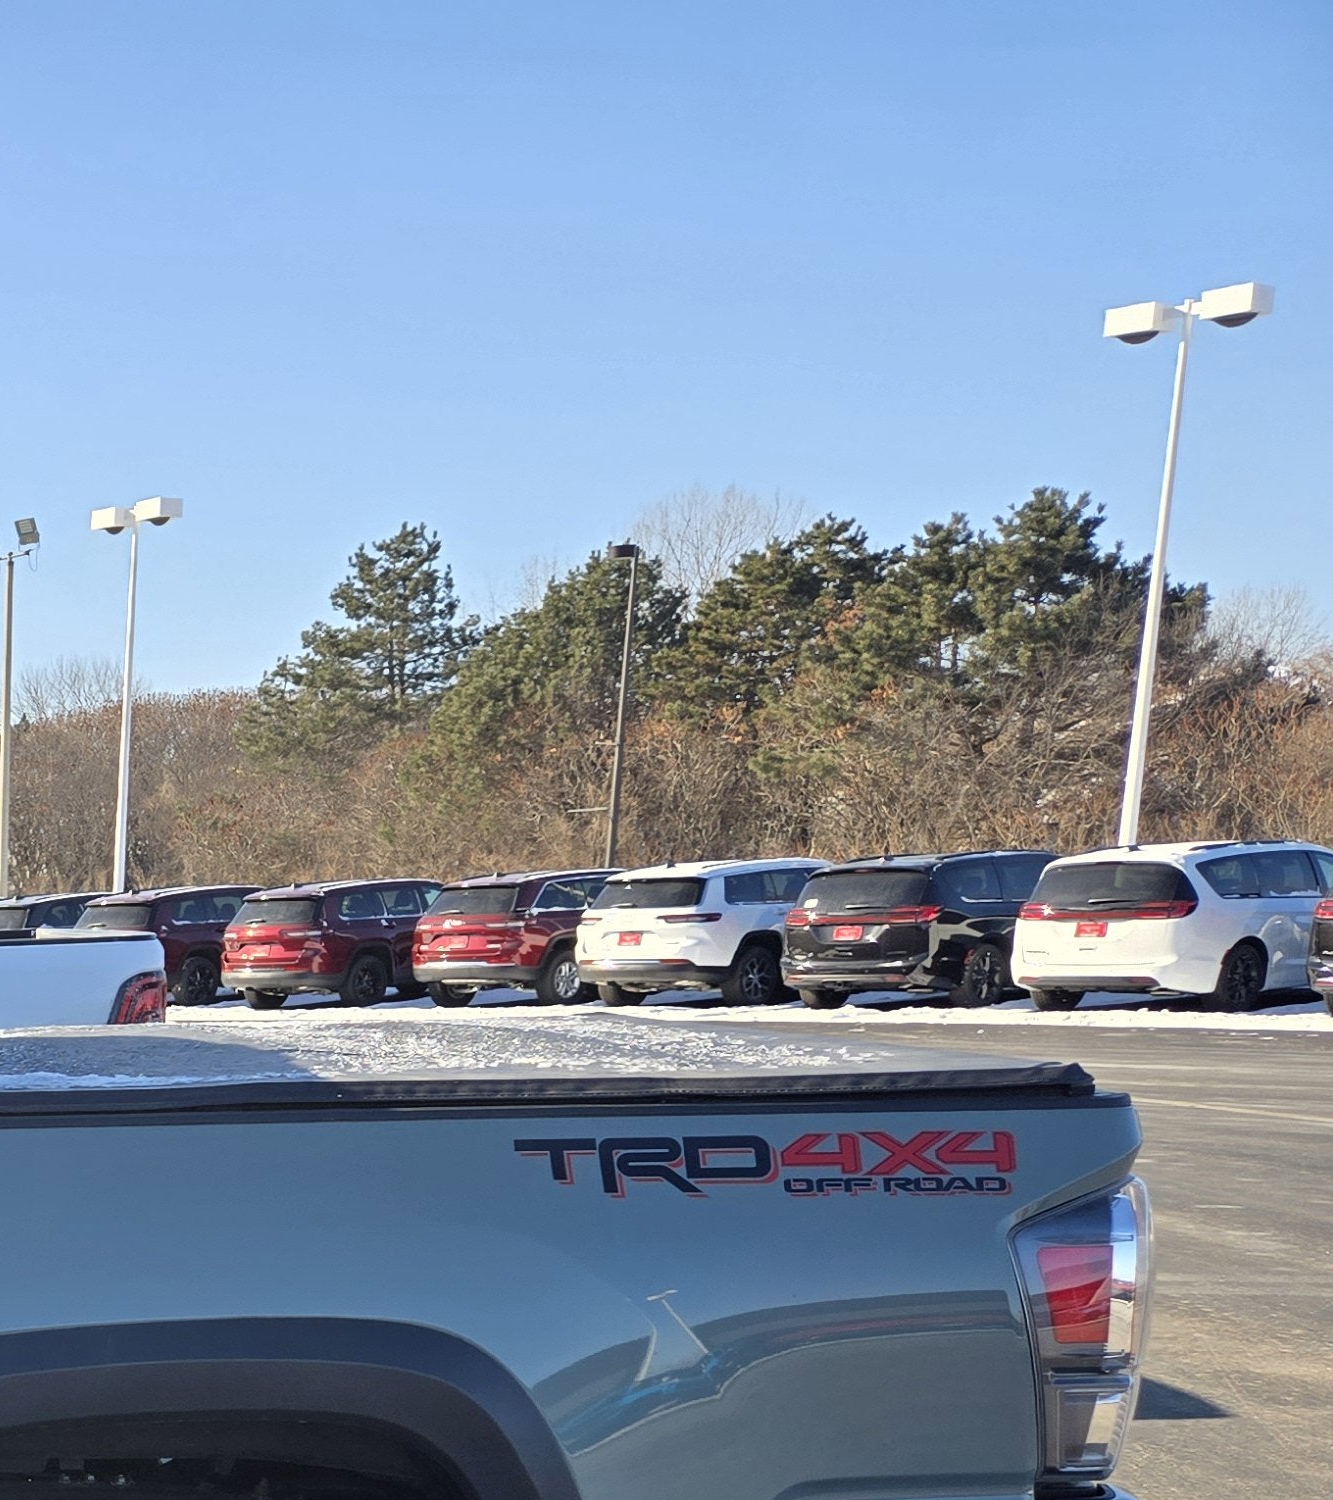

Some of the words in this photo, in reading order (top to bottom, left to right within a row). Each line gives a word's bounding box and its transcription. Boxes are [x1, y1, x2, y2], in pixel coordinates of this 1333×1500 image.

[513, 1135, 779, 1198] TRD
[780, 1130, 1016, 1176] 4X4
[782, 1175, 876, 1197] OFF
[882, 1175, 1013, 1197] ROAD
